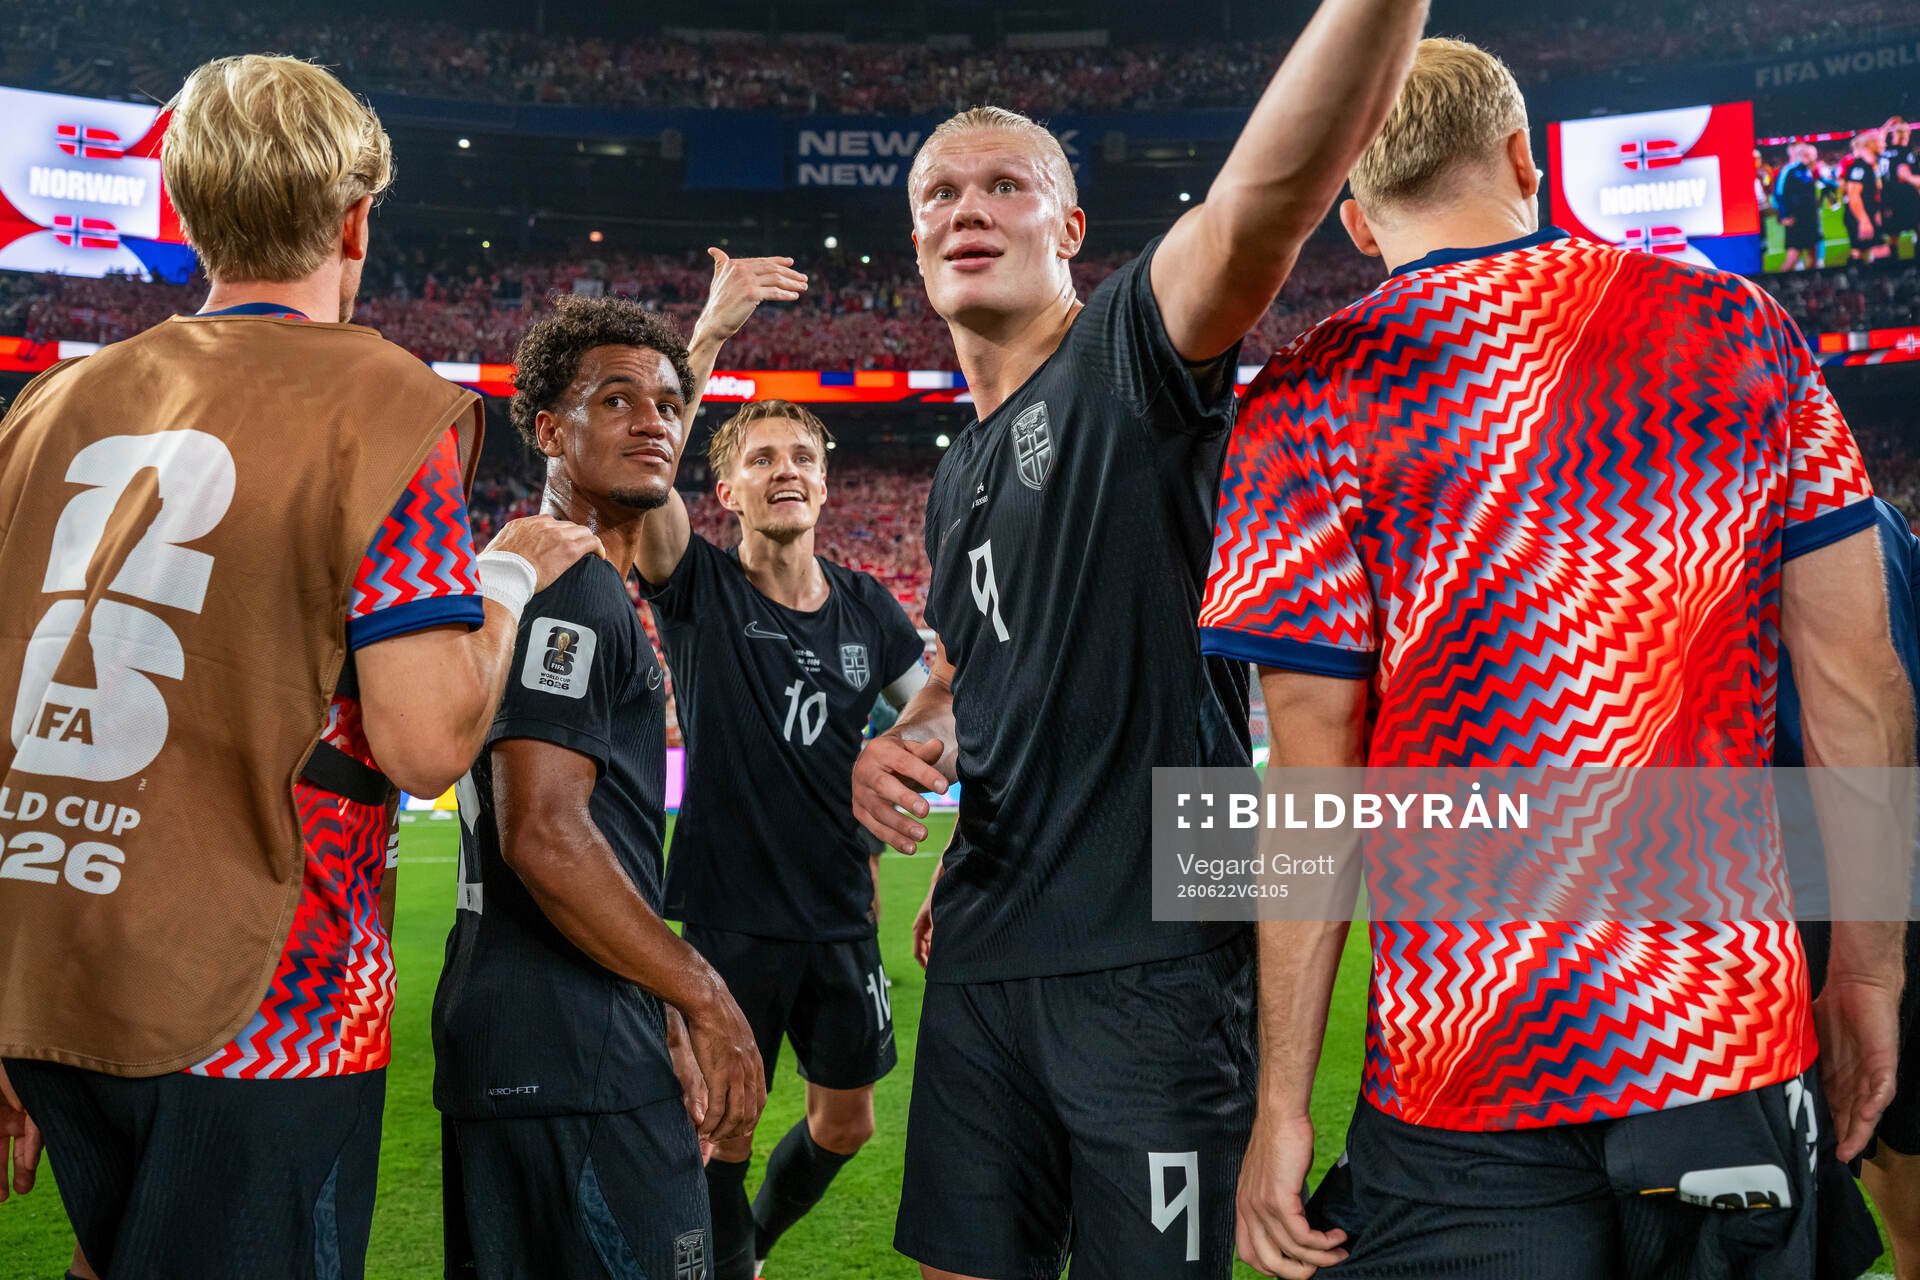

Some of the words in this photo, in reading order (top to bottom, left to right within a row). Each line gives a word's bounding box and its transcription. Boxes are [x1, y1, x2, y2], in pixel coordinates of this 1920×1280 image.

[1755, 61, 1820, 88] FIFA
[1824, 43, 1920, 76] WORL
[799, 131, 920, 157] NEW
[29, 165, 146, 207] NORWAY
[799, 164, 898, 186] NEW
[1600, 178, 1706, 216] NORWAY
[968, 539, 1010, 642] 9
[538, 677, 570, 690] 2026
[540, 672, 559, 681] WORLD
[551, 662, 565, 672] FIFA
[783, 679, 828, 746] 10
[55, 796, 141, 837] CUP
[1148, 1151, 1200, 1261] 9
